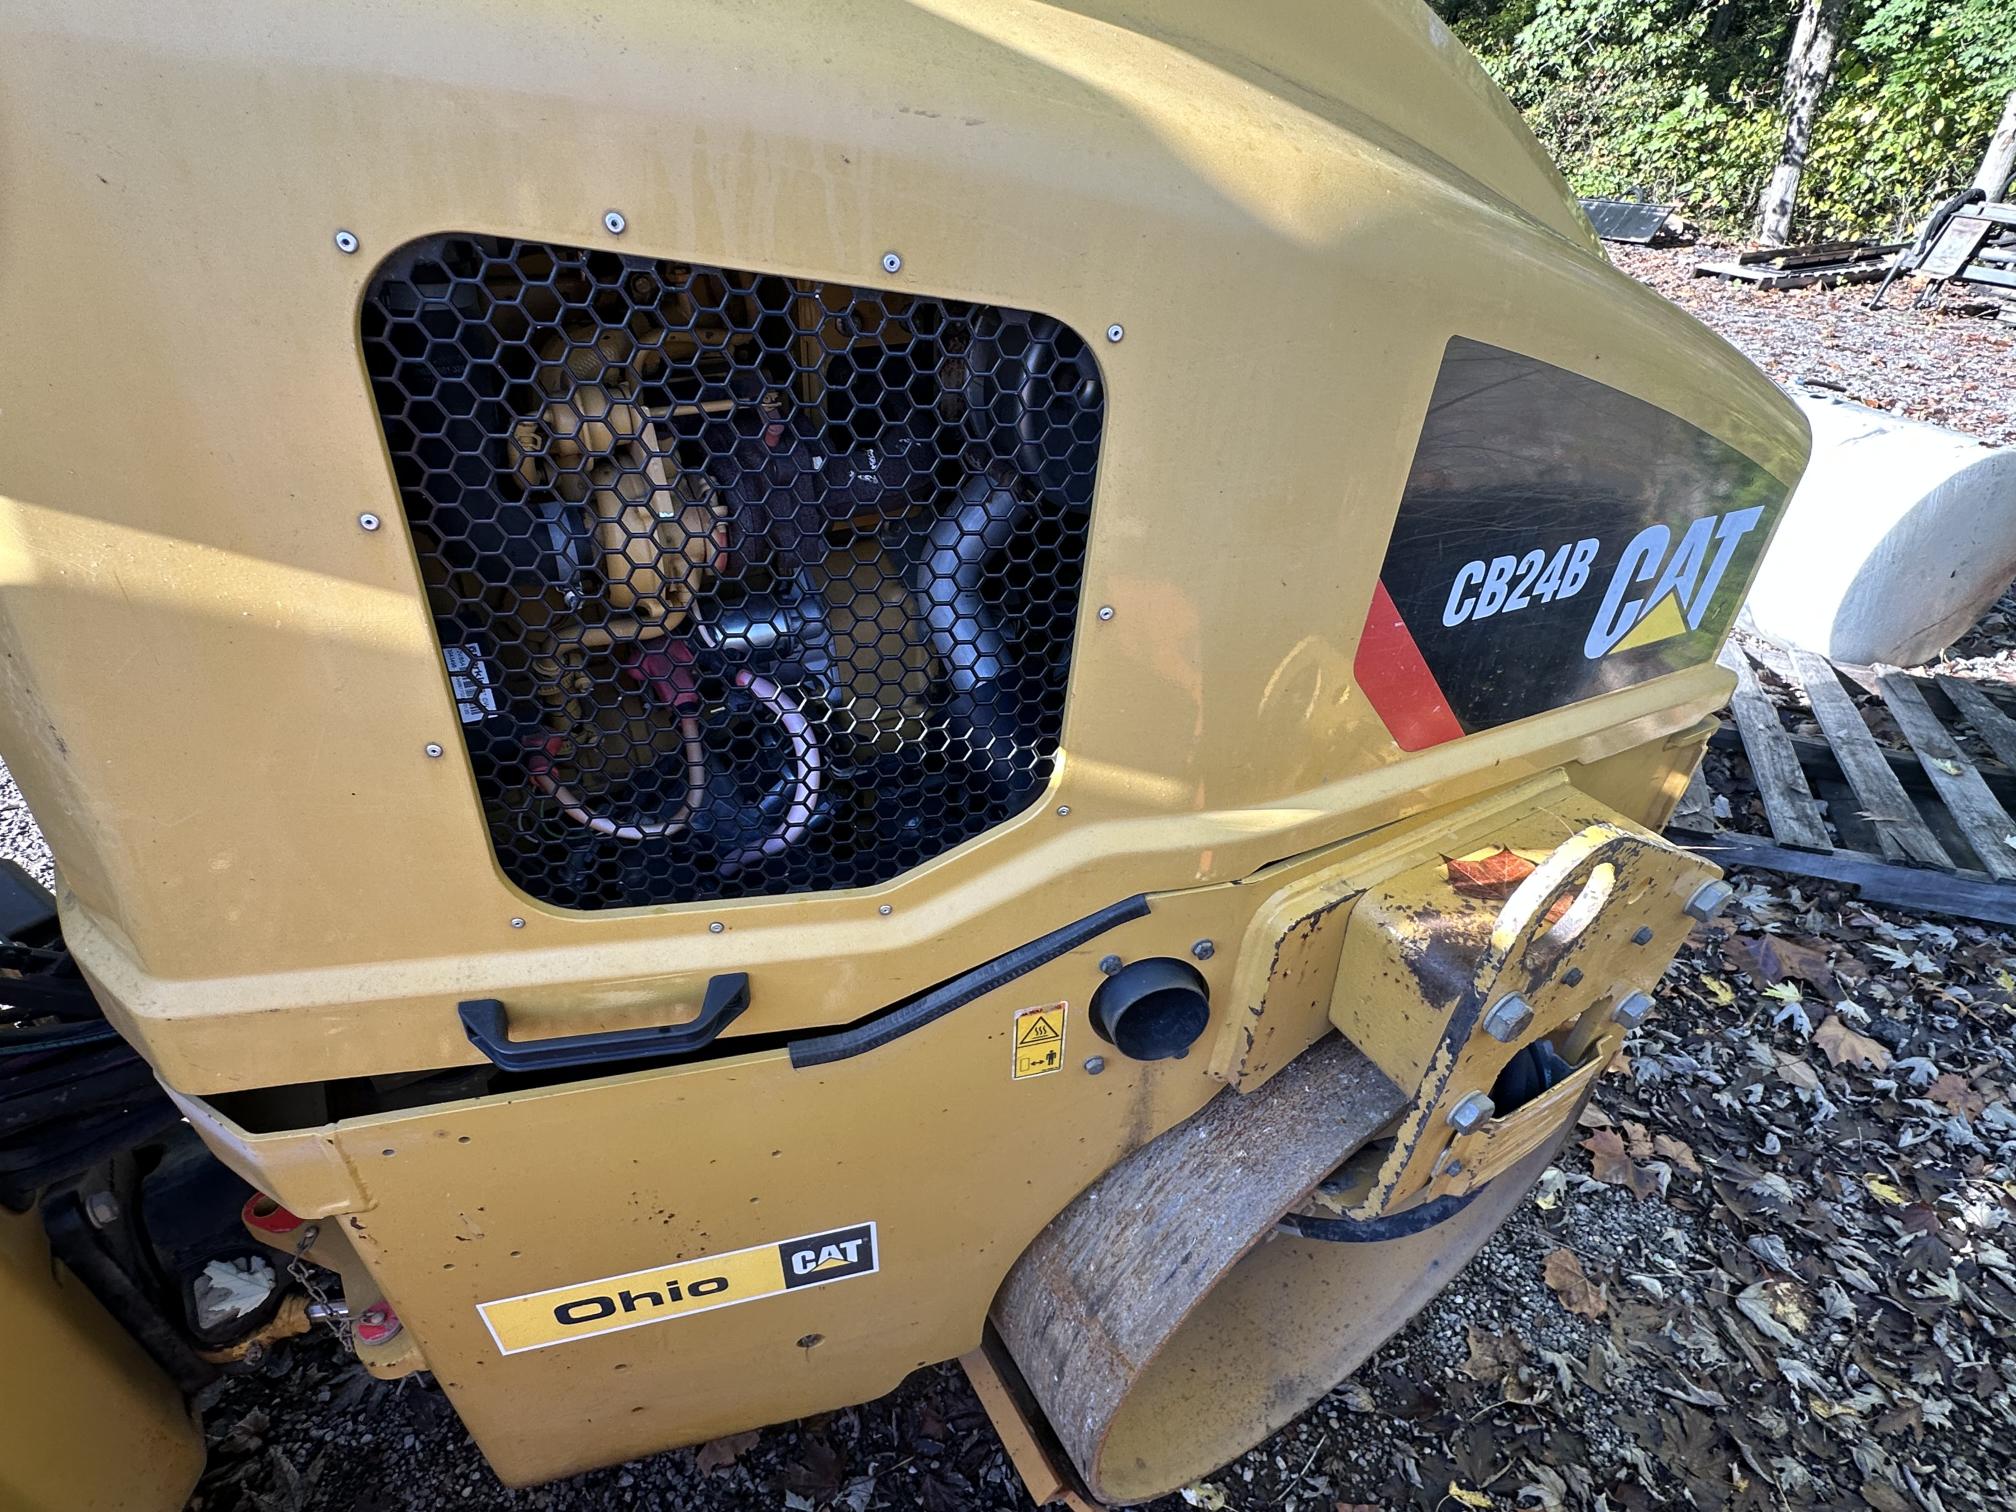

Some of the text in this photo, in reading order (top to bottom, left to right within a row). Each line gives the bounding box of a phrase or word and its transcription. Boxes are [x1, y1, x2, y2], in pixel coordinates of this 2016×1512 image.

[1442, 538, 1600, 628] CB24B
[1584, 505, 1765, 660] CAT
[554, 1238, 863, 1325] Ohio CAT
